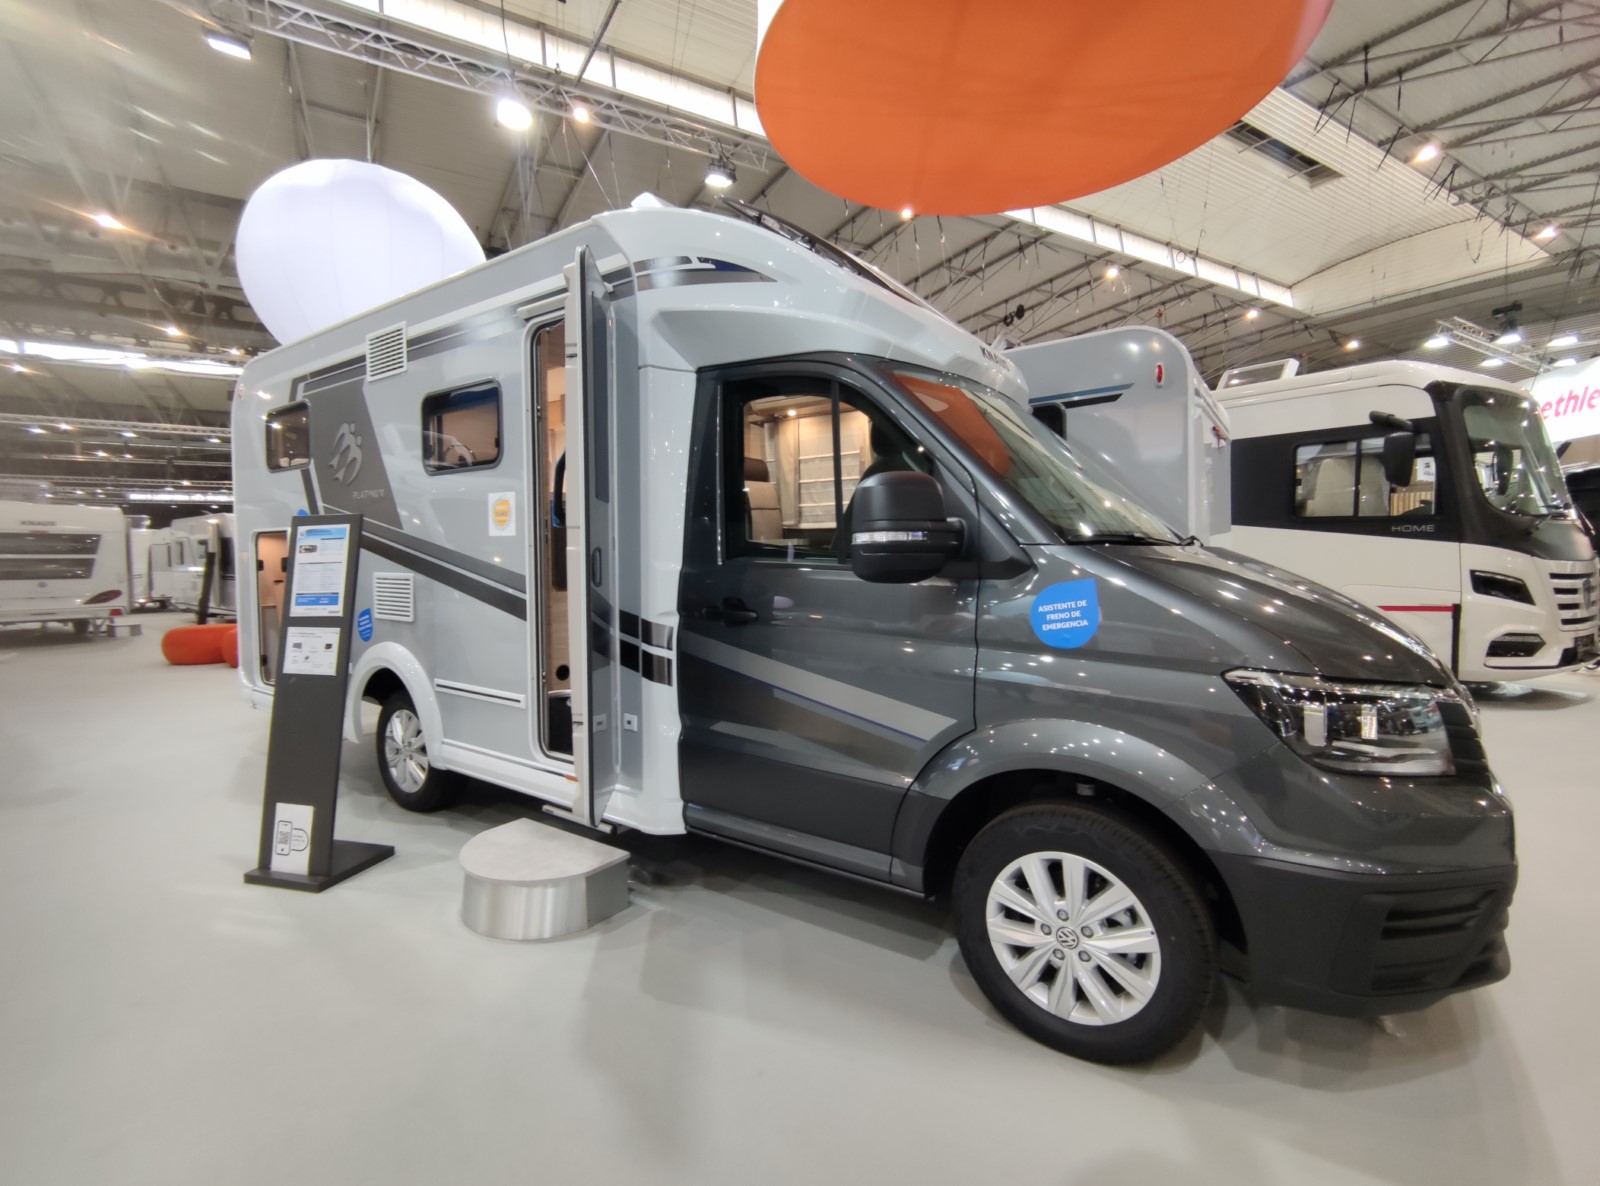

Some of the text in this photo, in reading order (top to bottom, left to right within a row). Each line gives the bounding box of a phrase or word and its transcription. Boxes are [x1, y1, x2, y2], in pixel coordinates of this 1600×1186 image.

[1392, 524, 1435, 532] HOME
[1038, 602, 1076, 612] ASISTENTE
[1046, 612, 1069, 620] FRENO
[1042, 620, 1088, 630] EMERGENCIA
